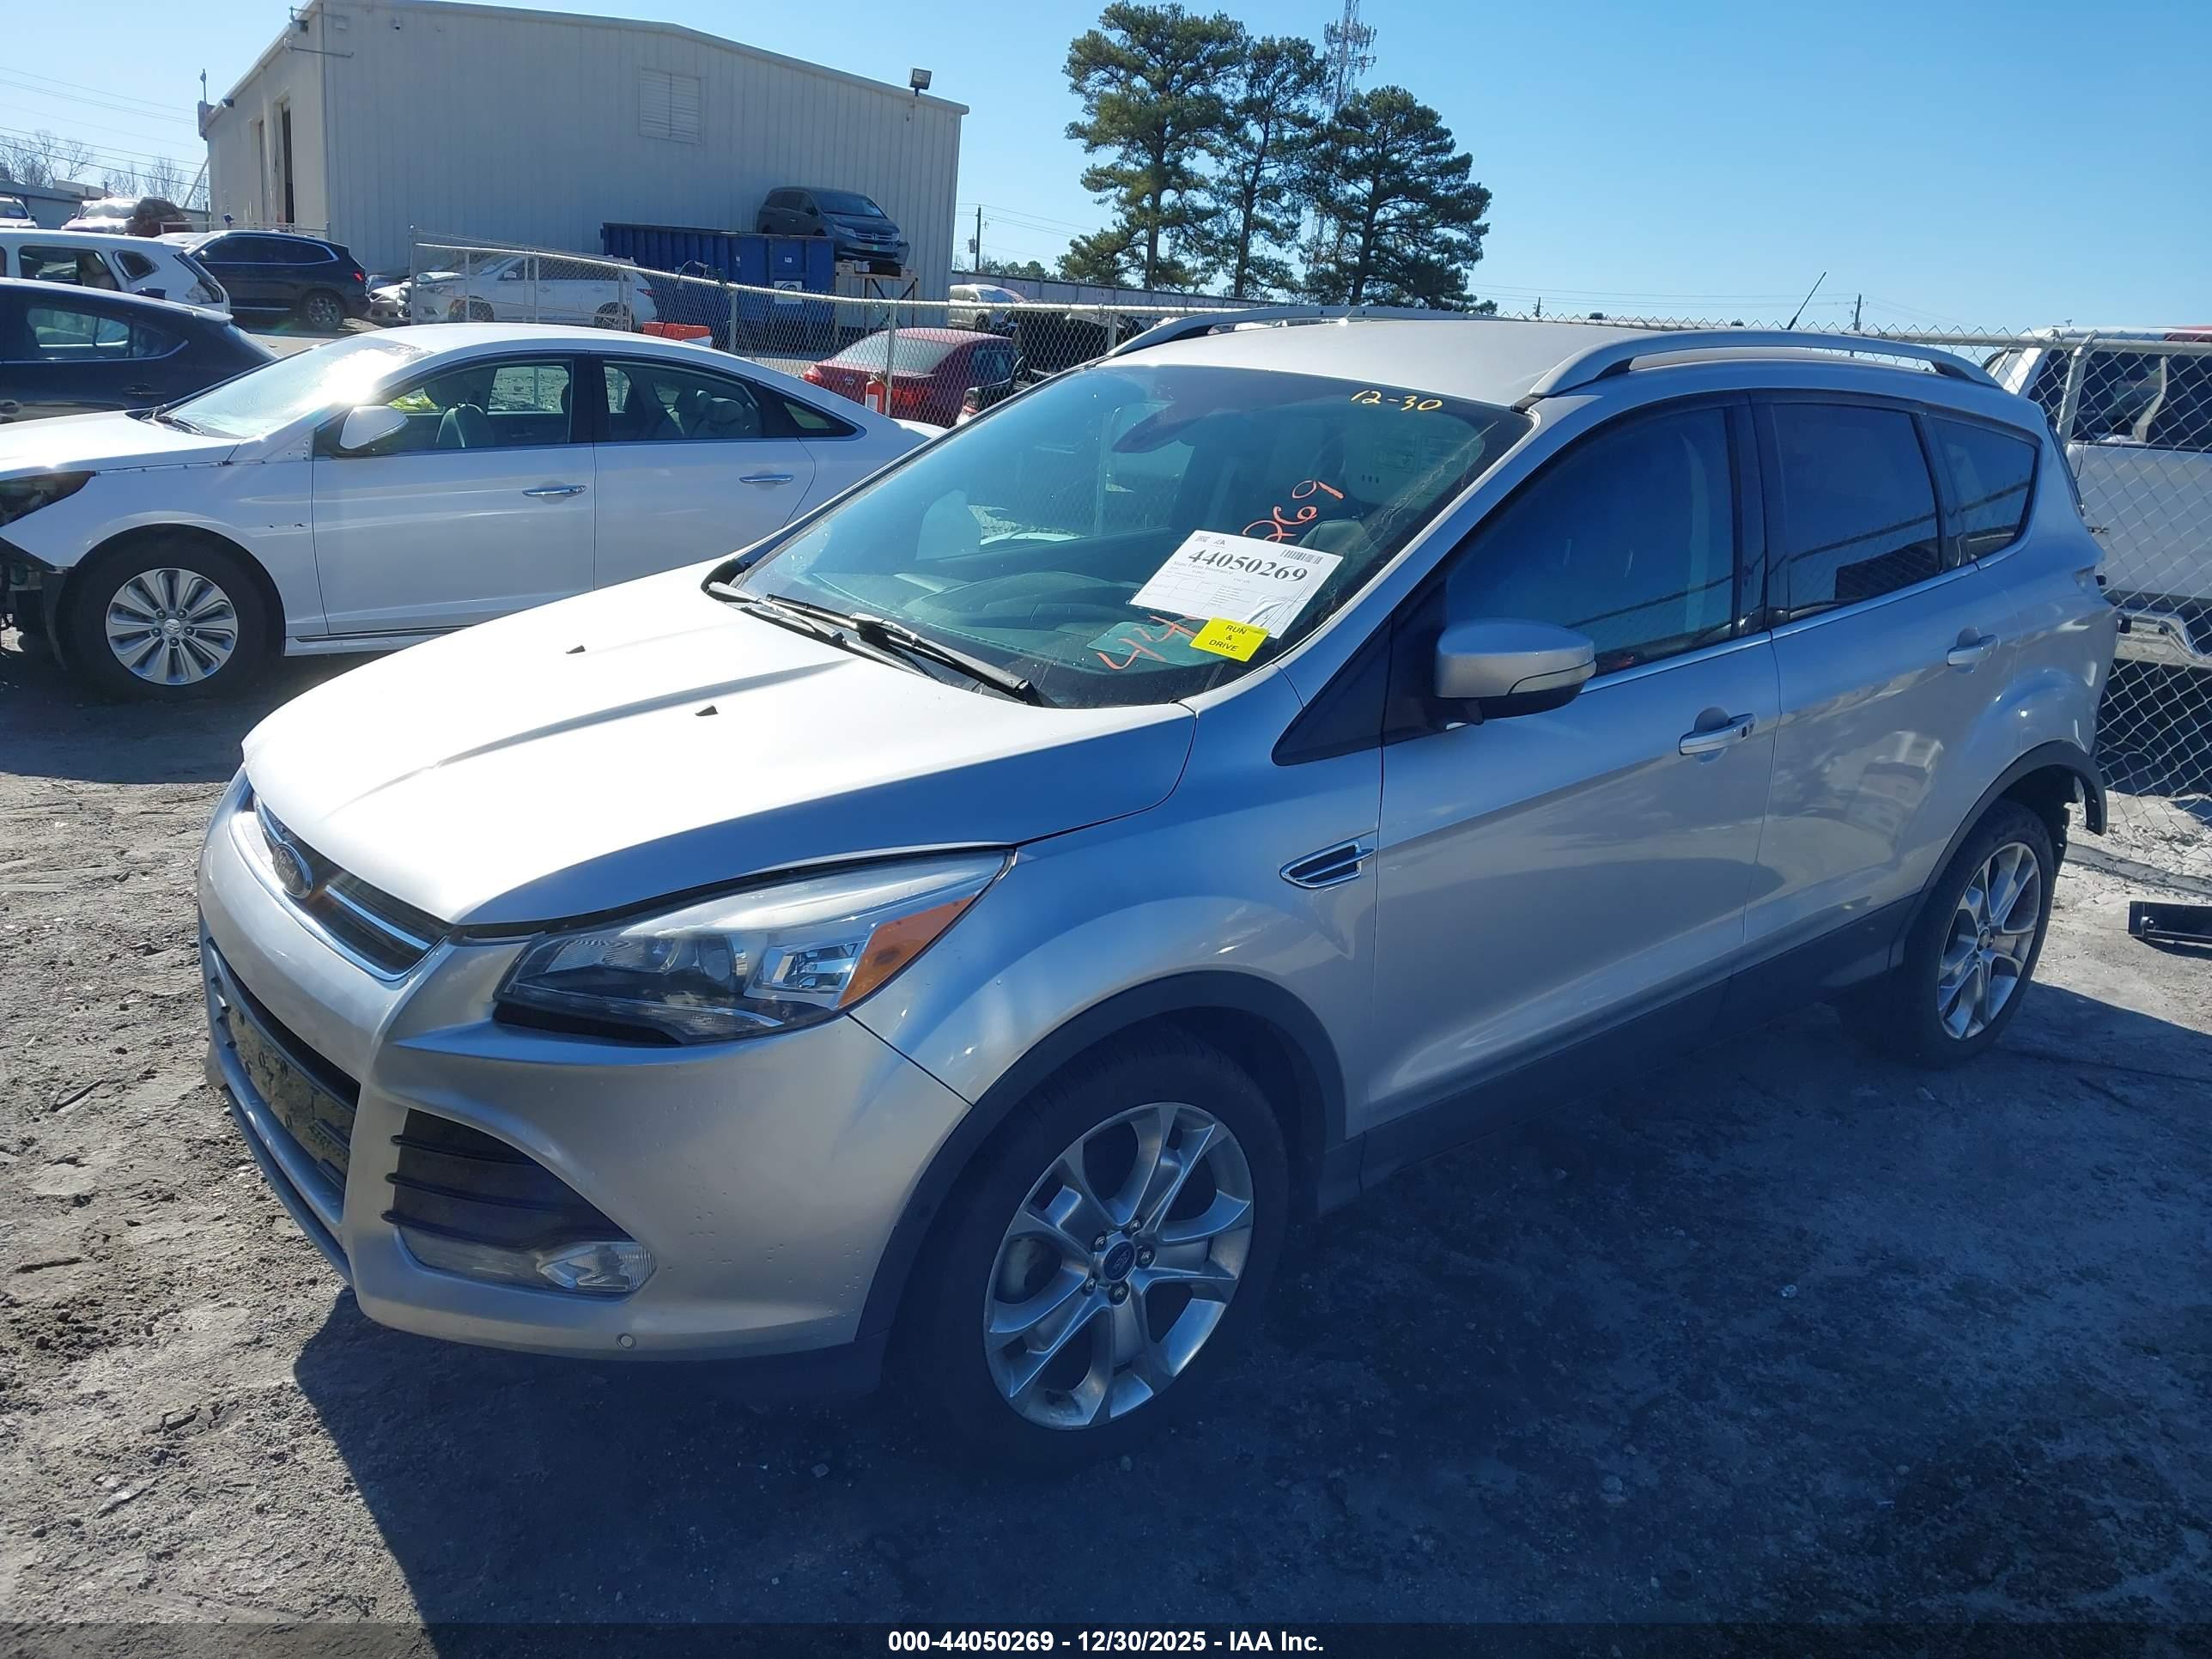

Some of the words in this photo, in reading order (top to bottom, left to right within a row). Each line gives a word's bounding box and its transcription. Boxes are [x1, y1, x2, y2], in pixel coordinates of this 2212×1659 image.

[1350, 389, 1443, 411] 12-30
[1188, 549, 1309, 582] 44050269
[1224, 624, 1248, 635] RUN
[1208, 639, 1240, 653] DRIVE
